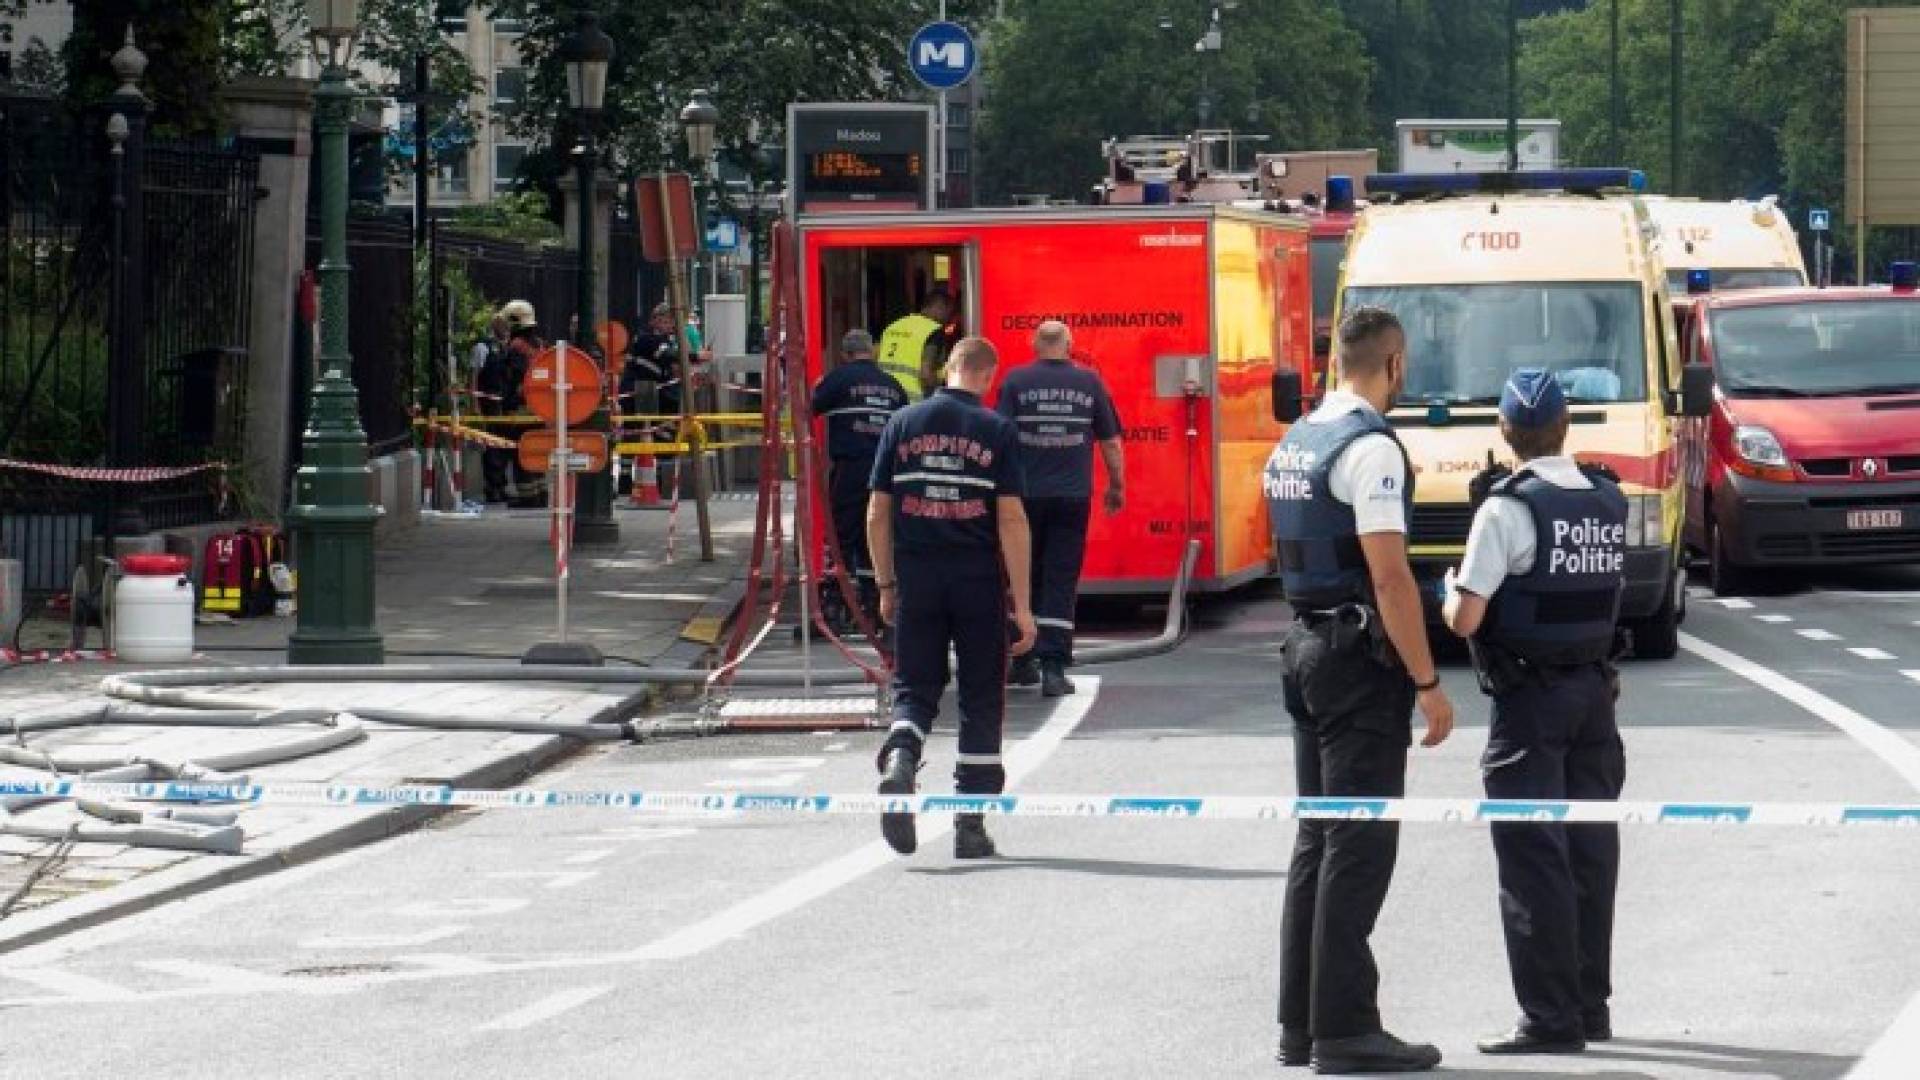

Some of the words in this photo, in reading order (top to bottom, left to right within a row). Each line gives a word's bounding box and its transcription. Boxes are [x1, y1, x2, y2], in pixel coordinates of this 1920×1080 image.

[920, 42, 965, 68] M
[836, 128, 881, 142] Madou
[1552, 517, 1624, 546] Police
[215, 539, 233, 557] 14
[1548, 545, 1624, 574] Politie
